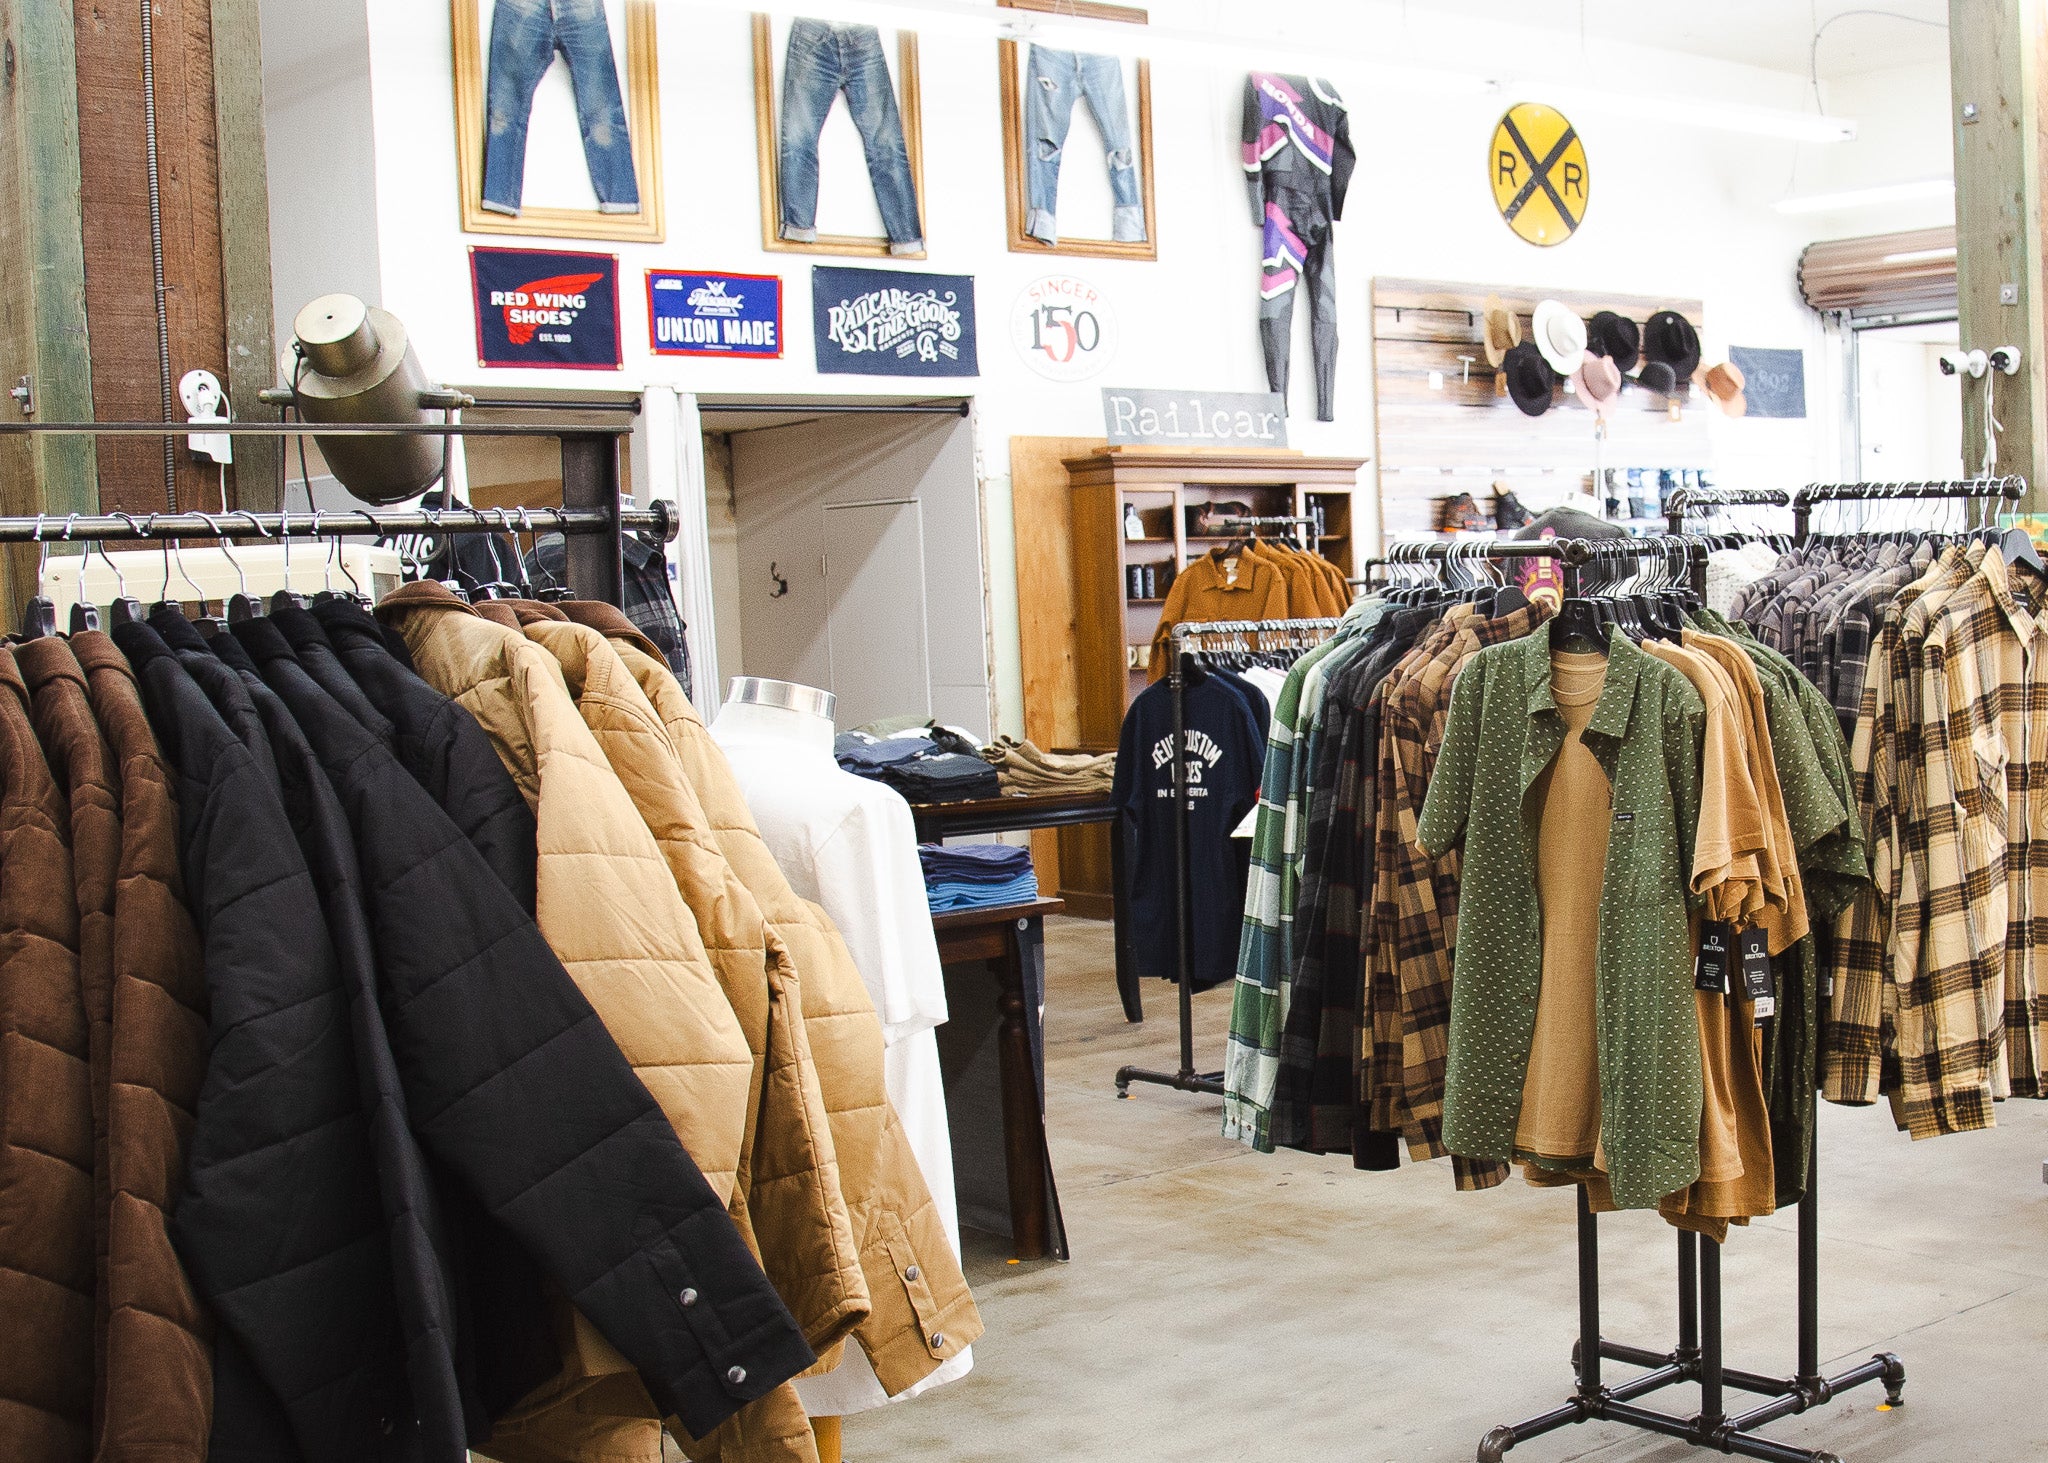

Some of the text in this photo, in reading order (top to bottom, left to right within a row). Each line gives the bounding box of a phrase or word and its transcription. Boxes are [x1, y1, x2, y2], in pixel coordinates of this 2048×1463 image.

[1498, 150, 1583, 199] R R
[490, 291, 587, 310] RED WING
[1028, 279, 1098, 305] SINGER
[657, 316, 776, 346] UNION MADE
[827, 288, 907, 353] RAILCAR
[866, 312, 909, 352] FINE
[905, 299, 962, 341] GOODS
[1029, 303, 1101, 363] 150
[1109, 396, 1280, 440] Railcar
